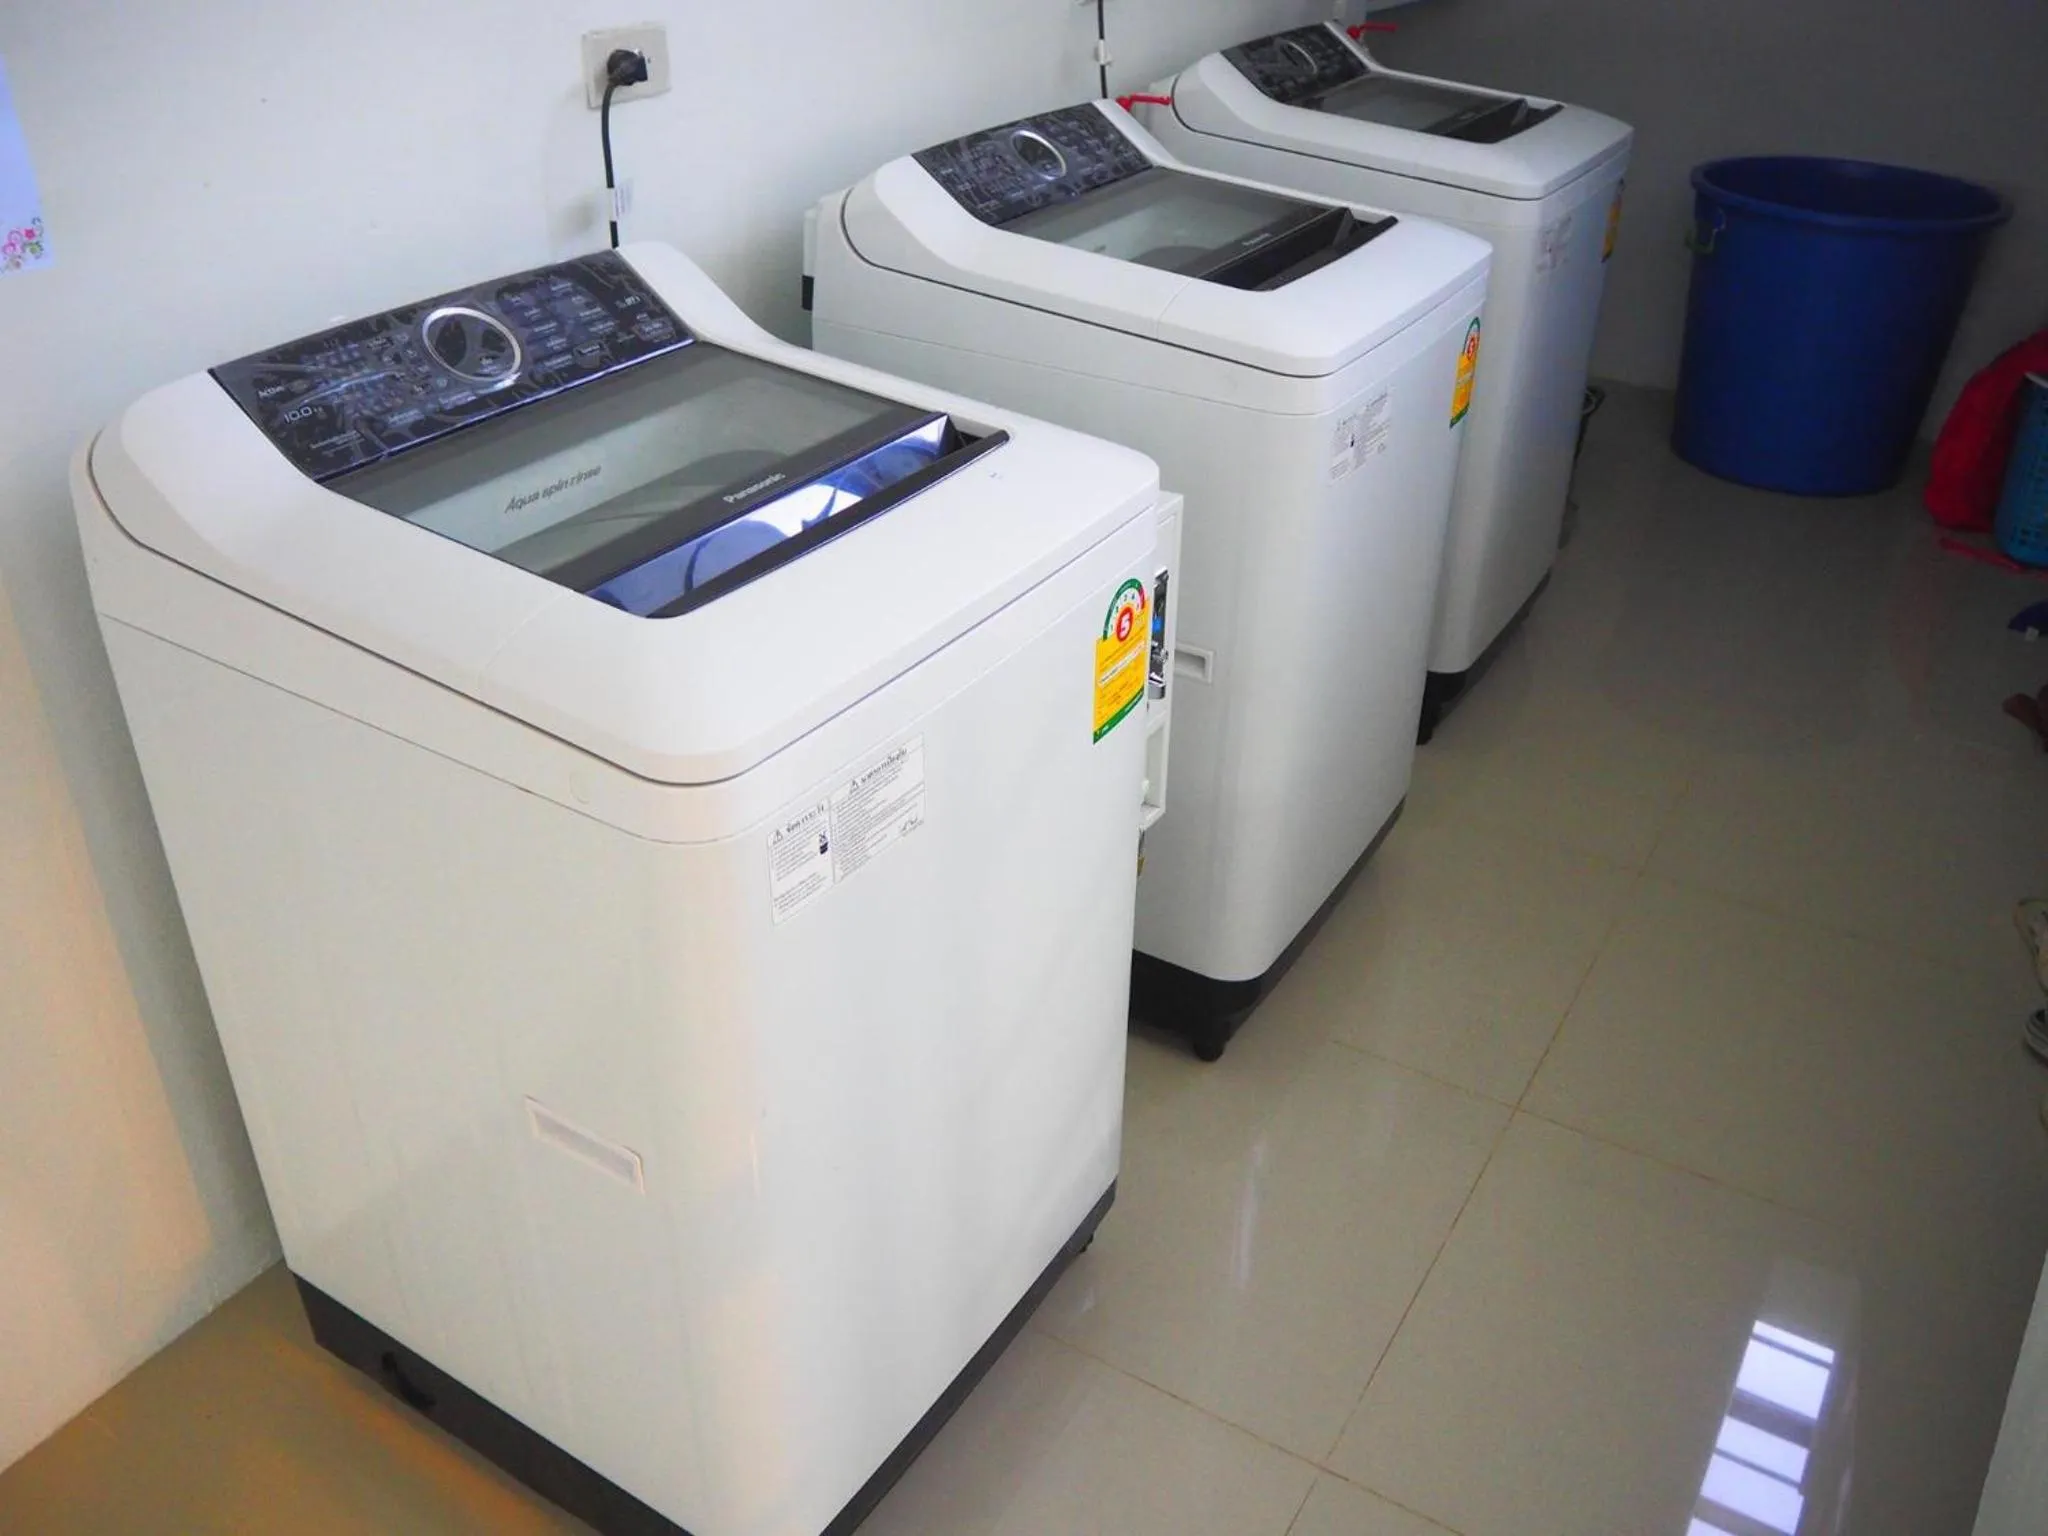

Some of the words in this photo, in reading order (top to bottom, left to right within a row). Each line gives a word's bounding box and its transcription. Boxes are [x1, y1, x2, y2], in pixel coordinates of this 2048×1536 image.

[504, 491, 541, 514] Aqua
[541, 477, 569, 500] spin
[569, 465, 602, 487] rinse
[723, 472, 787, 503] Panasonic
